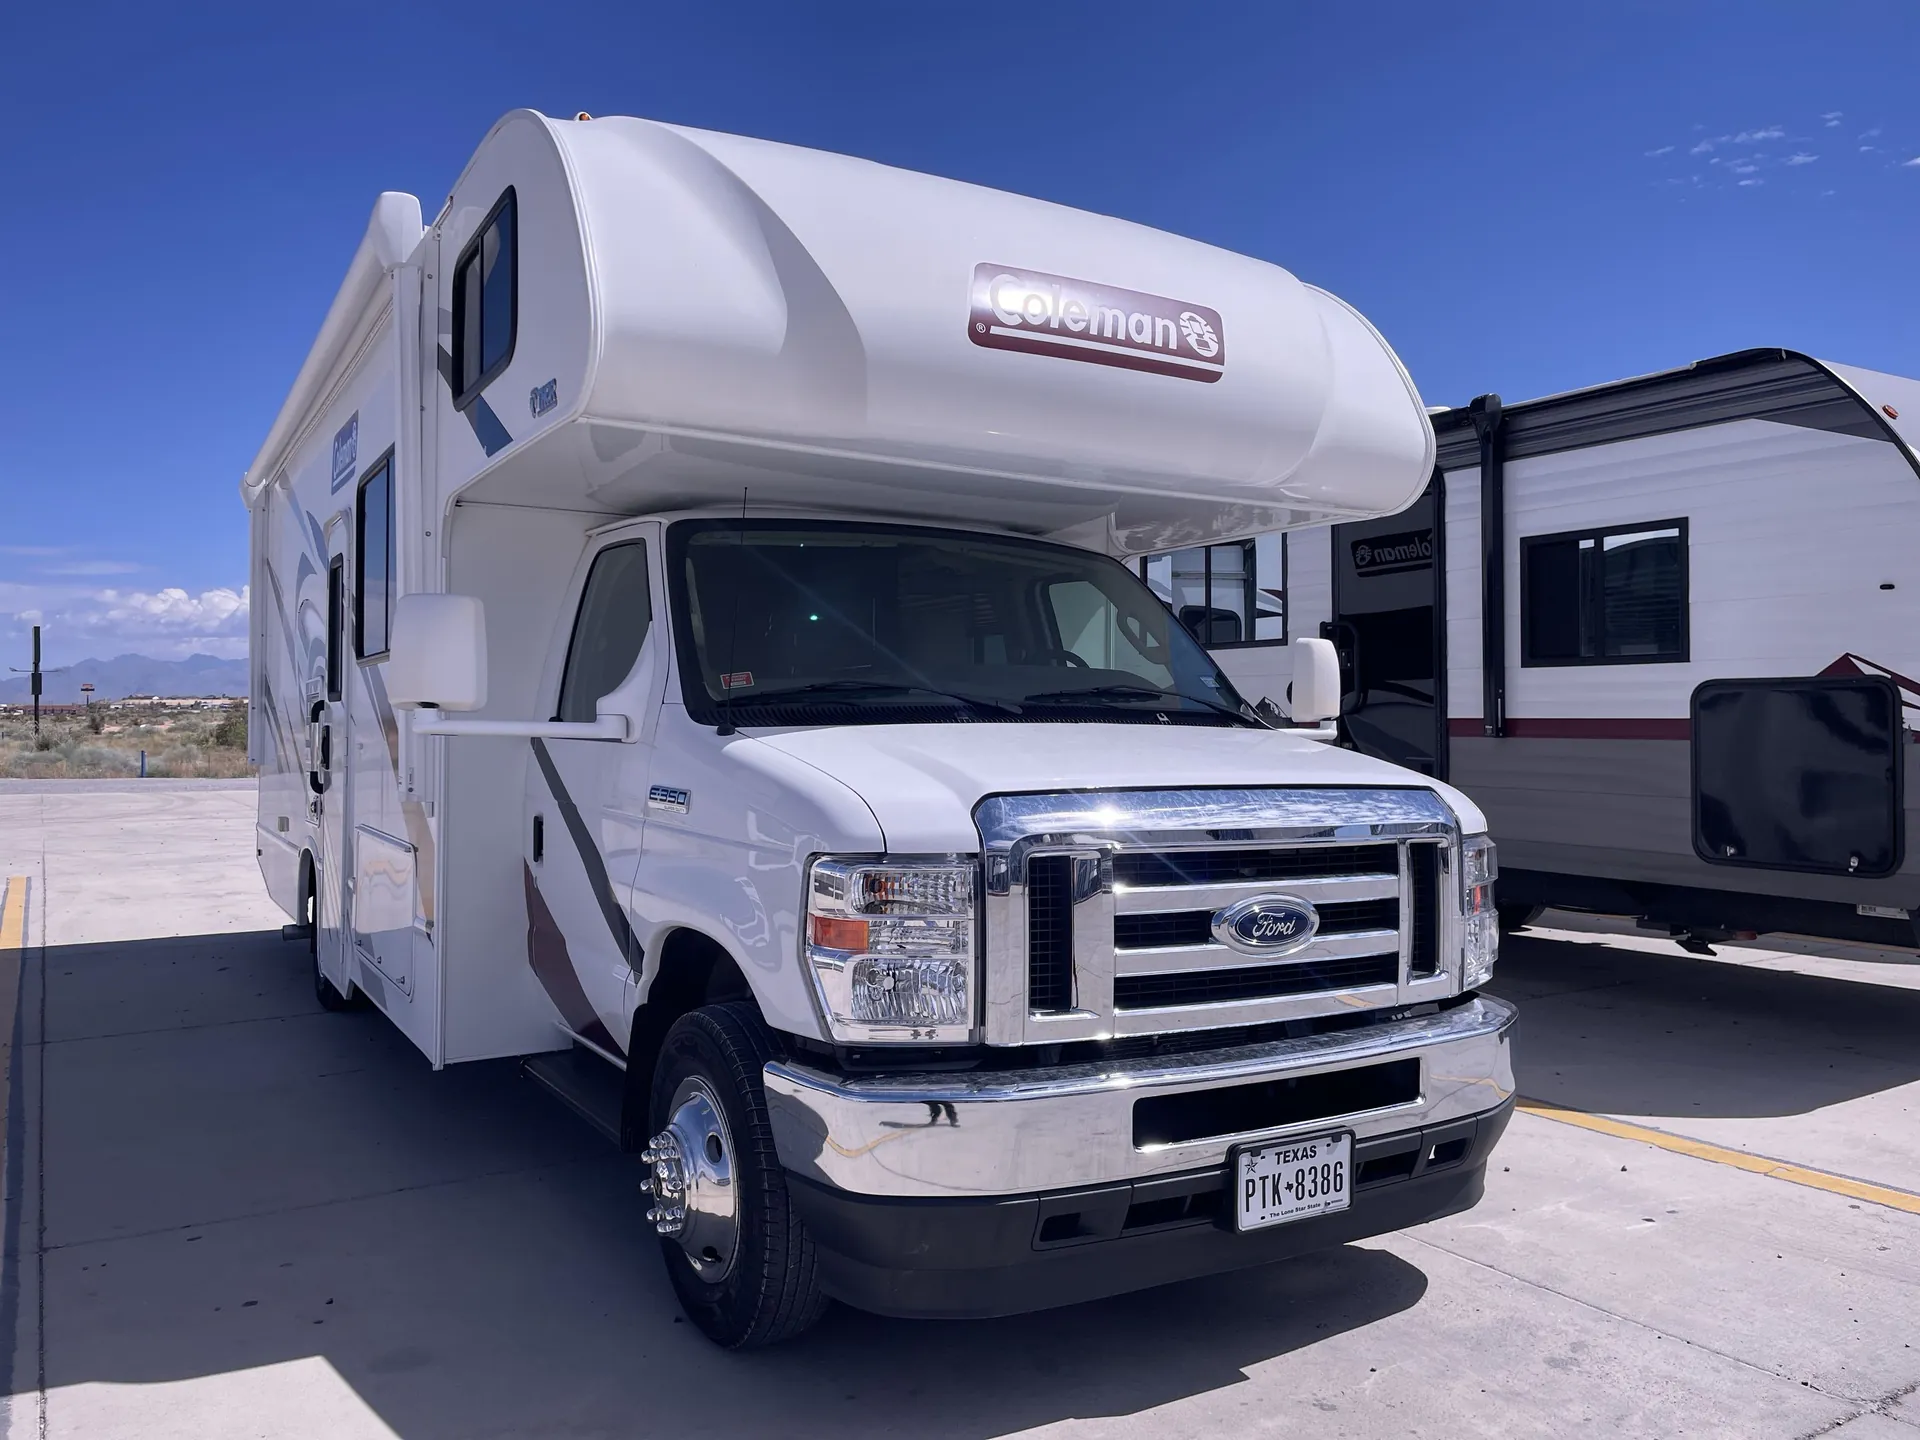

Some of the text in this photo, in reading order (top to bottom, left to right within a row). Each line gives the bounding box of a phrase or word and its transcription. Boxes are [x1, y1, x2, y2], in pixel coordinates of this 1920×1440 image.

[989, 273, 1177, 350] Coleman
[1252, 912, 1297, 937] Ford
[1275, 1145, 1317, 1165] TEXAS
[1245, 1161, 1343, 1212] PTK 8386
[1281, 1208, 1294, 1216] Lone
[1295, 1205, 1307, 1213] Star
[1307, 1202, 1321, 1210] State
